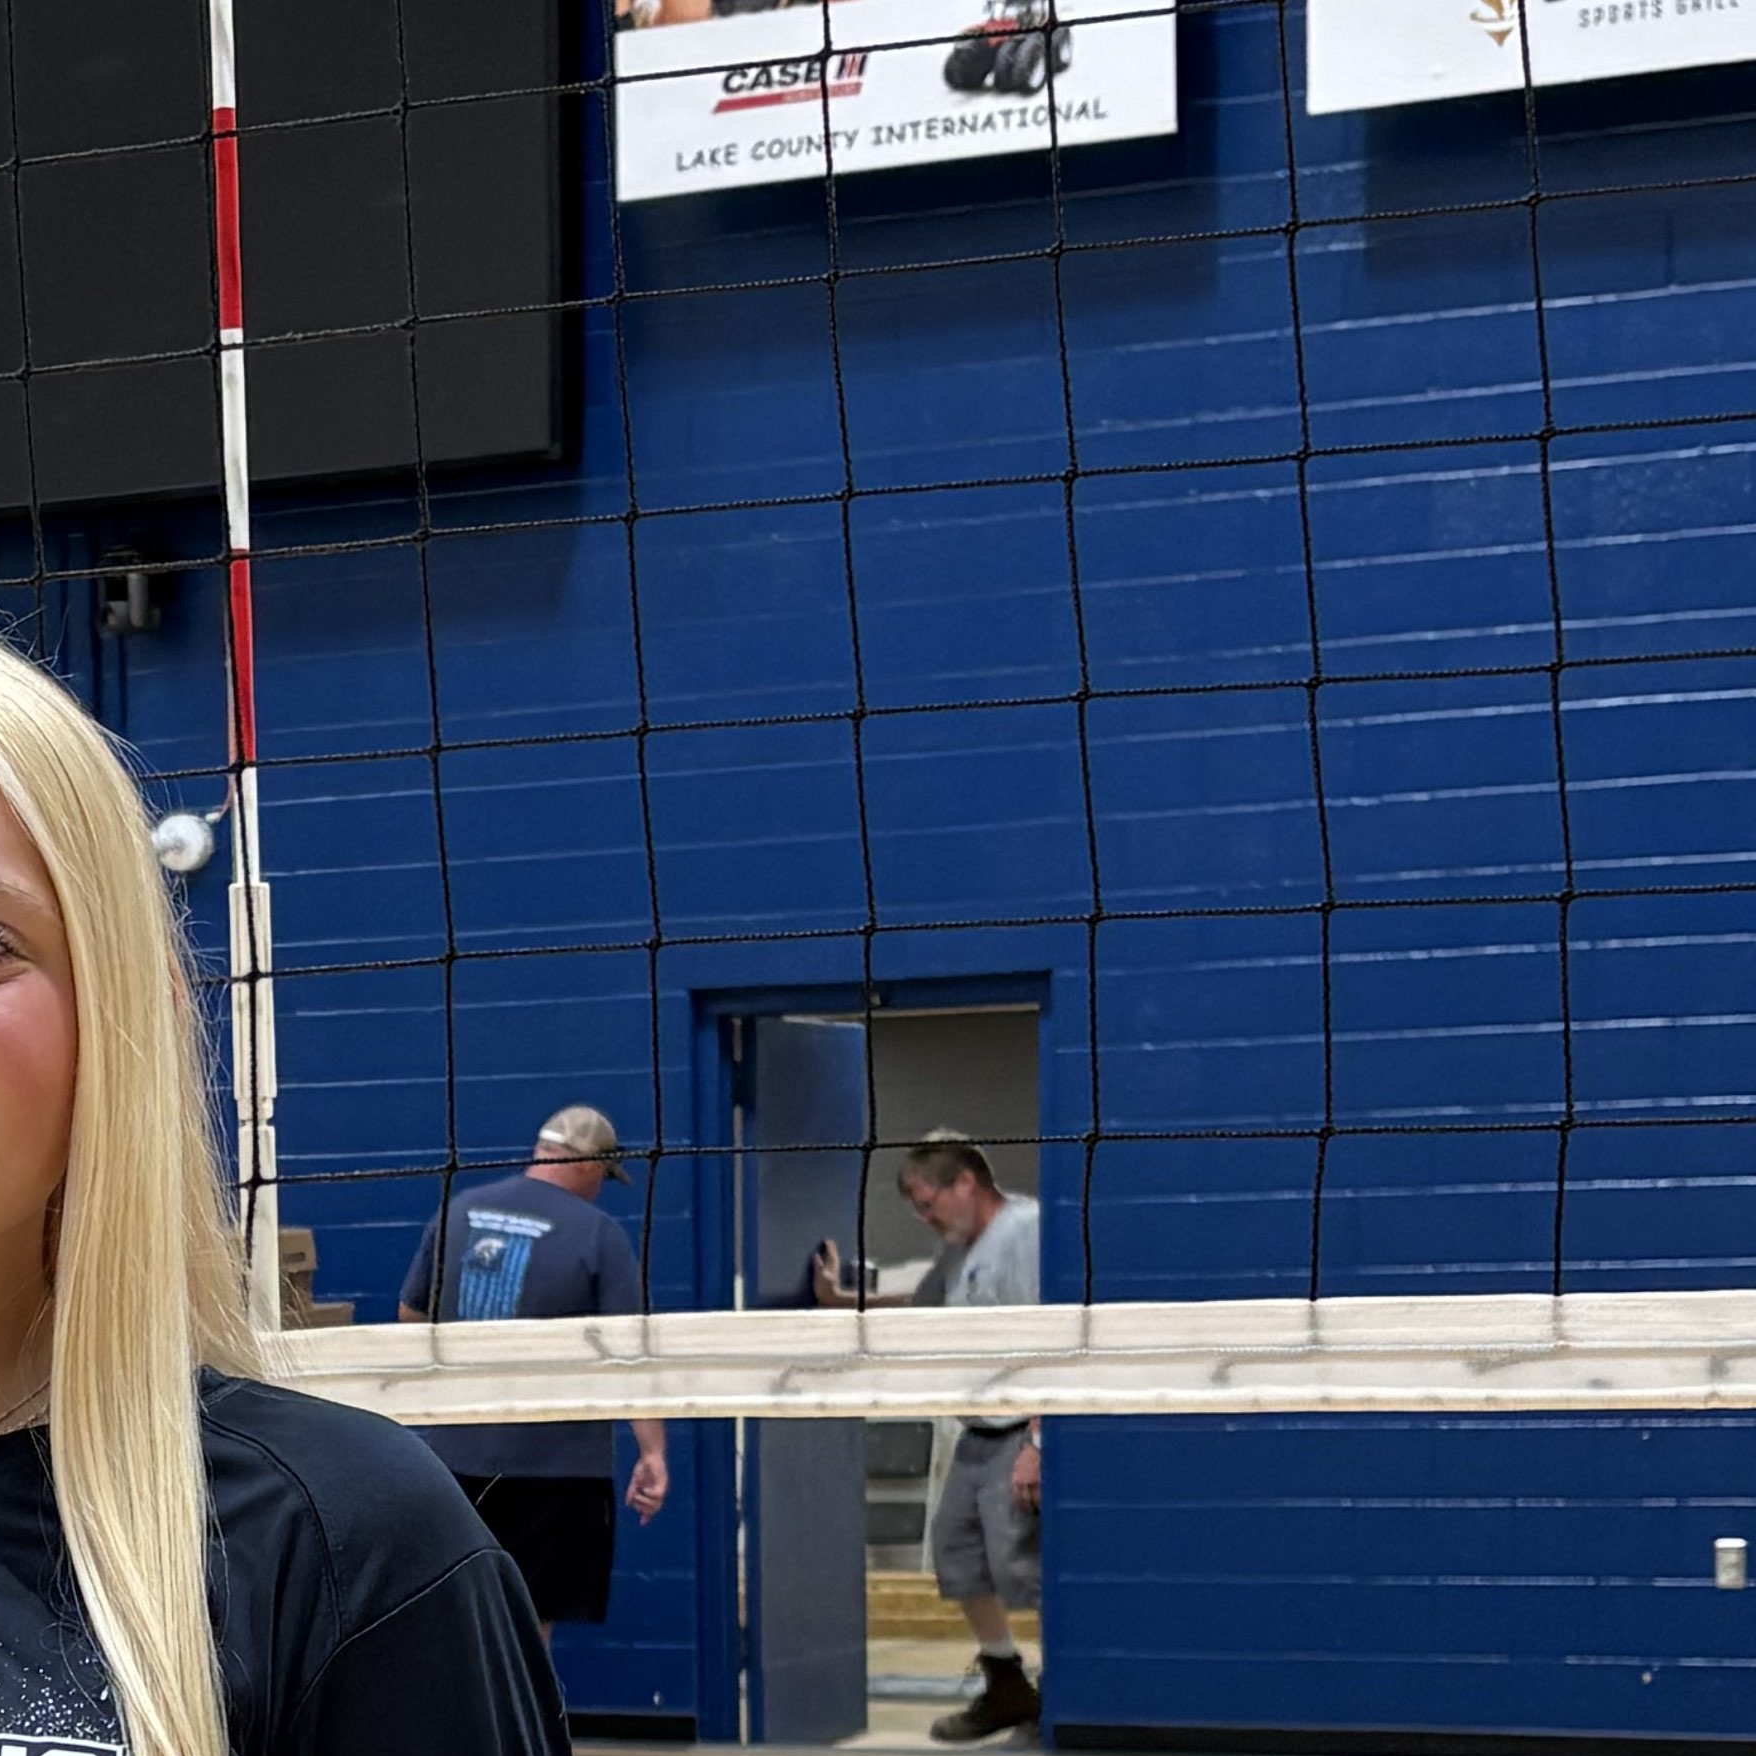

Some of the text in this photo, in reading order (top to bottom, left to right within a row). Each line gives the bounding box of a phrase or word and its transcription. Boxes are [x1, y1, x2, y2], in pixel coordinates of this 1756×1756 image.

[722, 61, 821, 94] CASE
[675, 98, 1107, 172] LAKE COUNTY INTERNATIONAL
